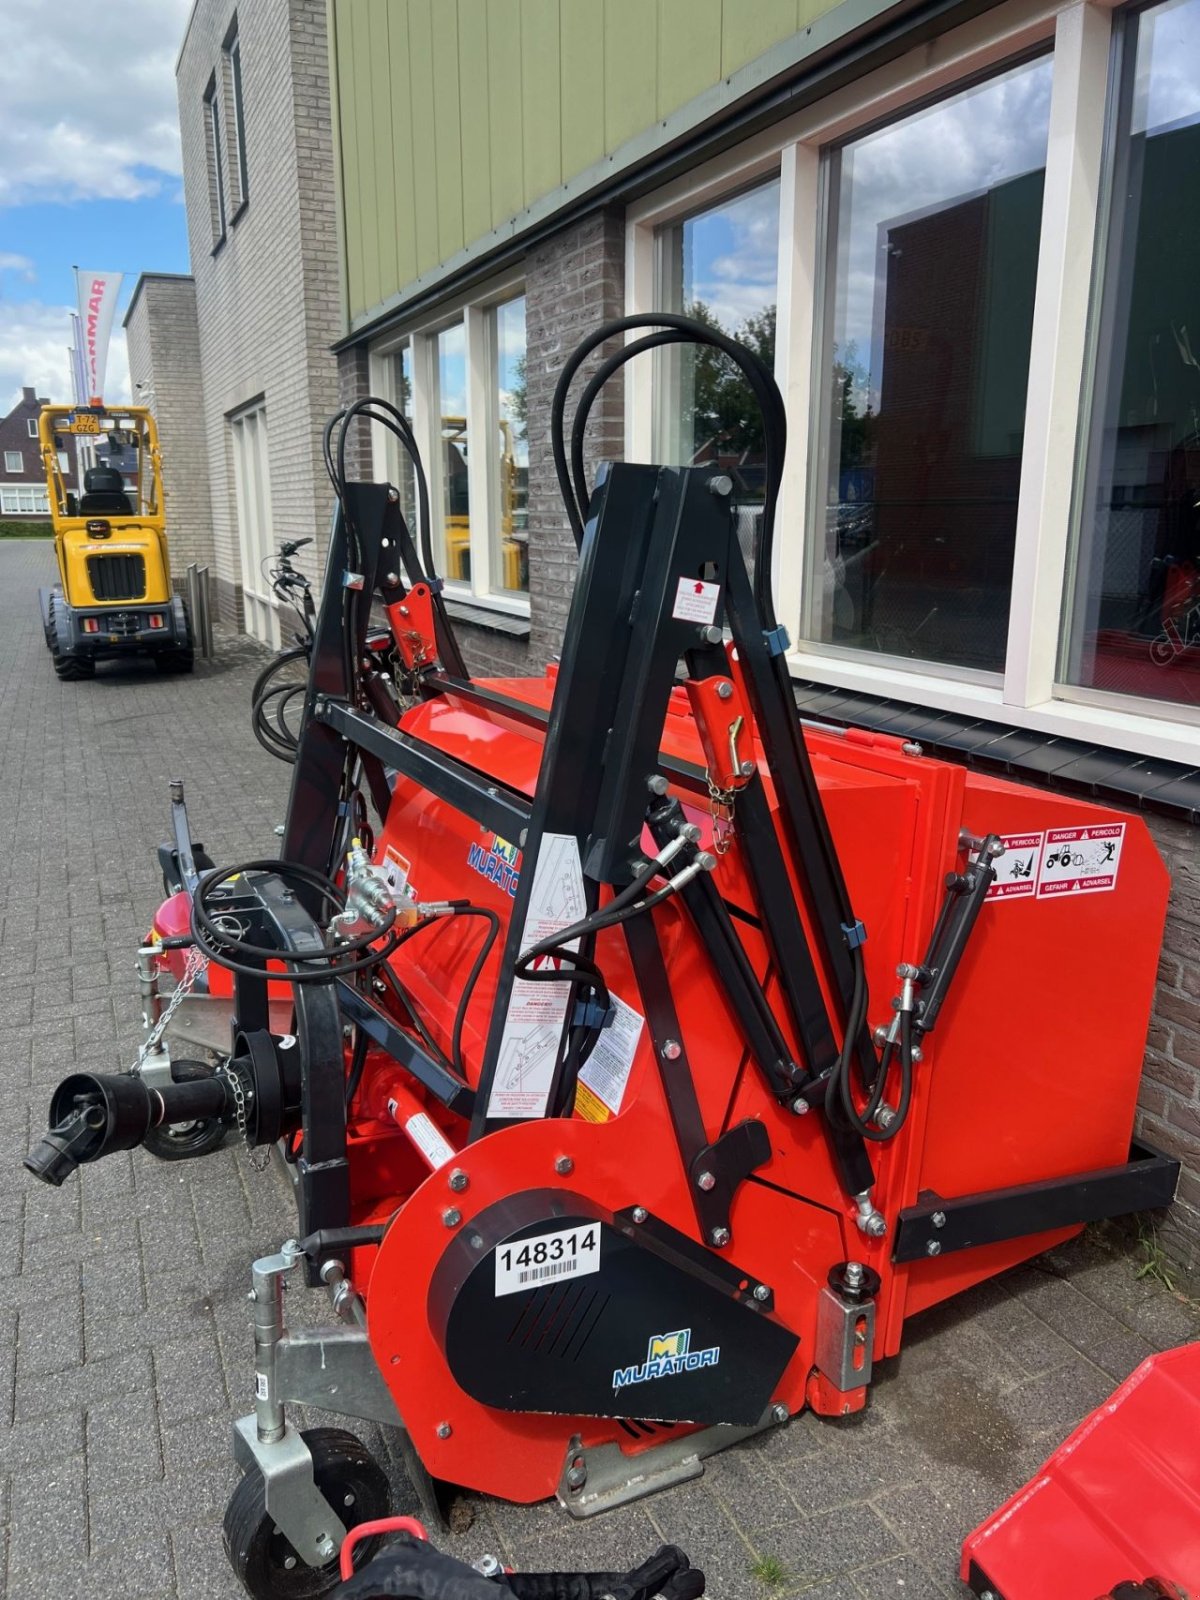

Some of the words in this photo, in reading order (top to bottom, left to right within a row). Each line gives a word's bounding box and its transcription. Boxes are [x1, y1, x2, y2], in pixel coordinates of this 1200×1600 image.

[76, 415, 97, 423] T-72
[1091, 827, 1121, 837] PERICOLO
[1011, 838, 1040, 846] PERICOLO
[467, 842, 521, 898] MURATO
[1005, 884, 1033, 893] ADVARSEL
[1044, 883, 1068, 891] GEFAHR
[1082, 878, 1111, 887] ADVARSEL
[501, 1230, 596, 1271] 148314
[613, 1347, 720, 1388] MURATORI
